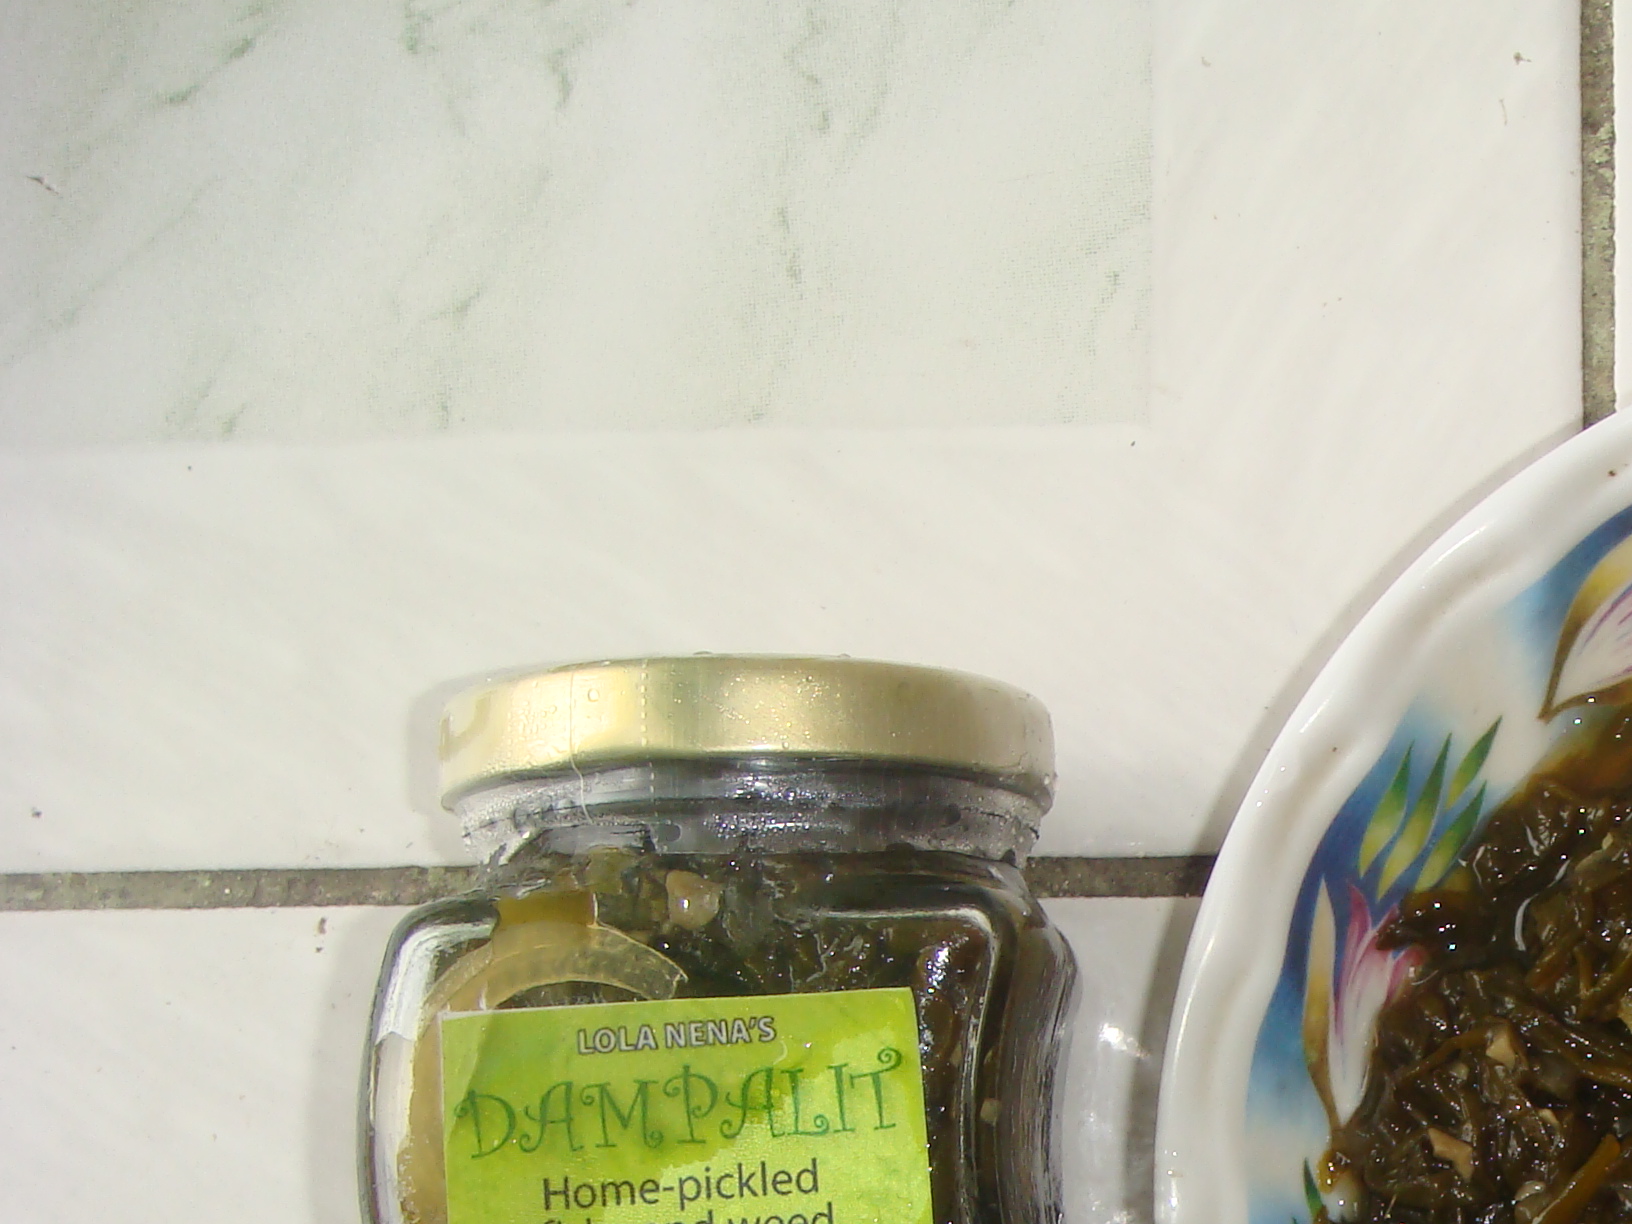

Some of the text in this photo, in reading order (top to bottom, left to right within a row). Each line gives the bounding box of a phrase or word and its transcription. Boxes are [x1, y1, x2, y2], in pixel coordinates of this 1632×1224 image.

[577, 1016, 777, 1055] LOLA NENA'S
[453, 1046, 903, 1160] DAMPALIT
[542, 1157, 820, 1213] Home-pickled
